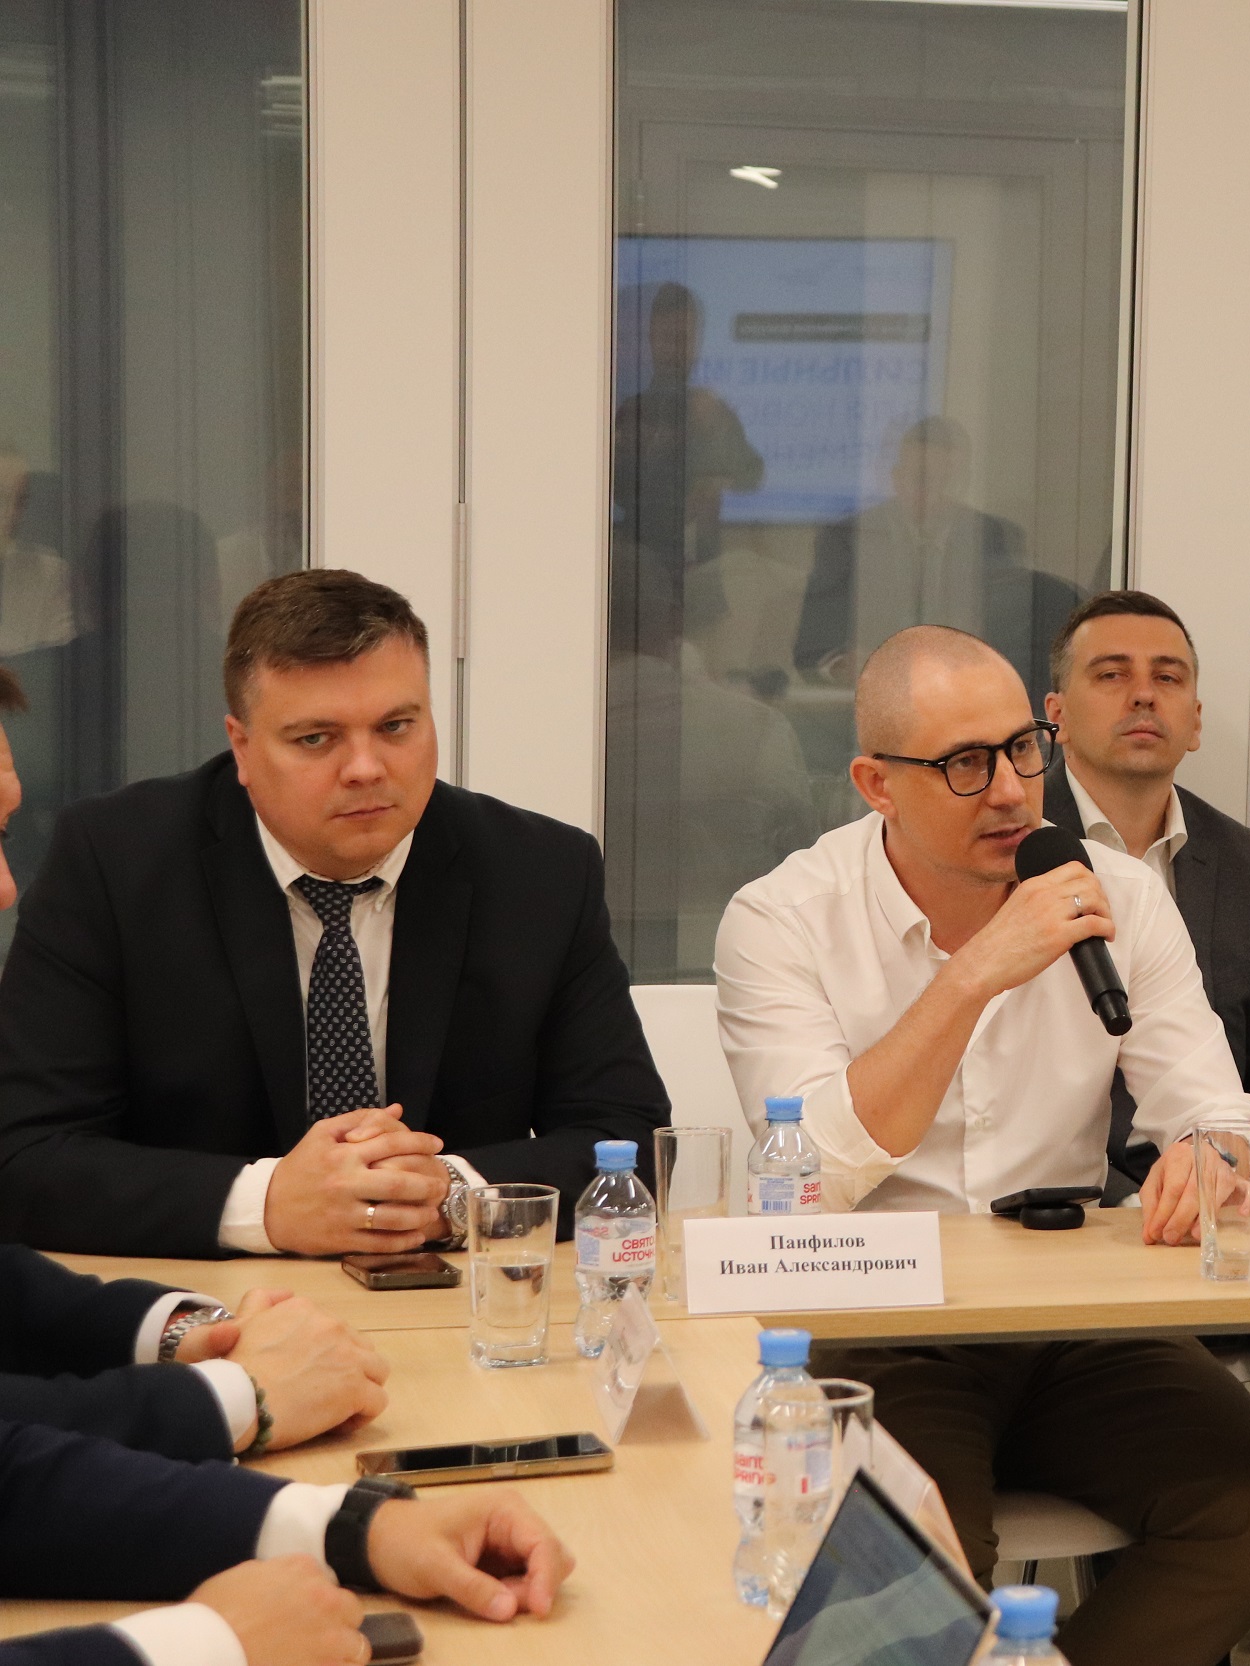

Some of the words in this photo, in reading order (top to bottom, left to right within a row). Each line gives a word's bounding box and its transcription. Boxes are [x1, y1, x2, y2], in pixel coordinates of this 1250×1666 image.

[622, 1236, 654, 1250] СВЯТО
[770, 1234, 866, 1252] Панфилов
[720, 1259, 769, 1275] Иван
[775, 1257, 918, 1275] Александрович
